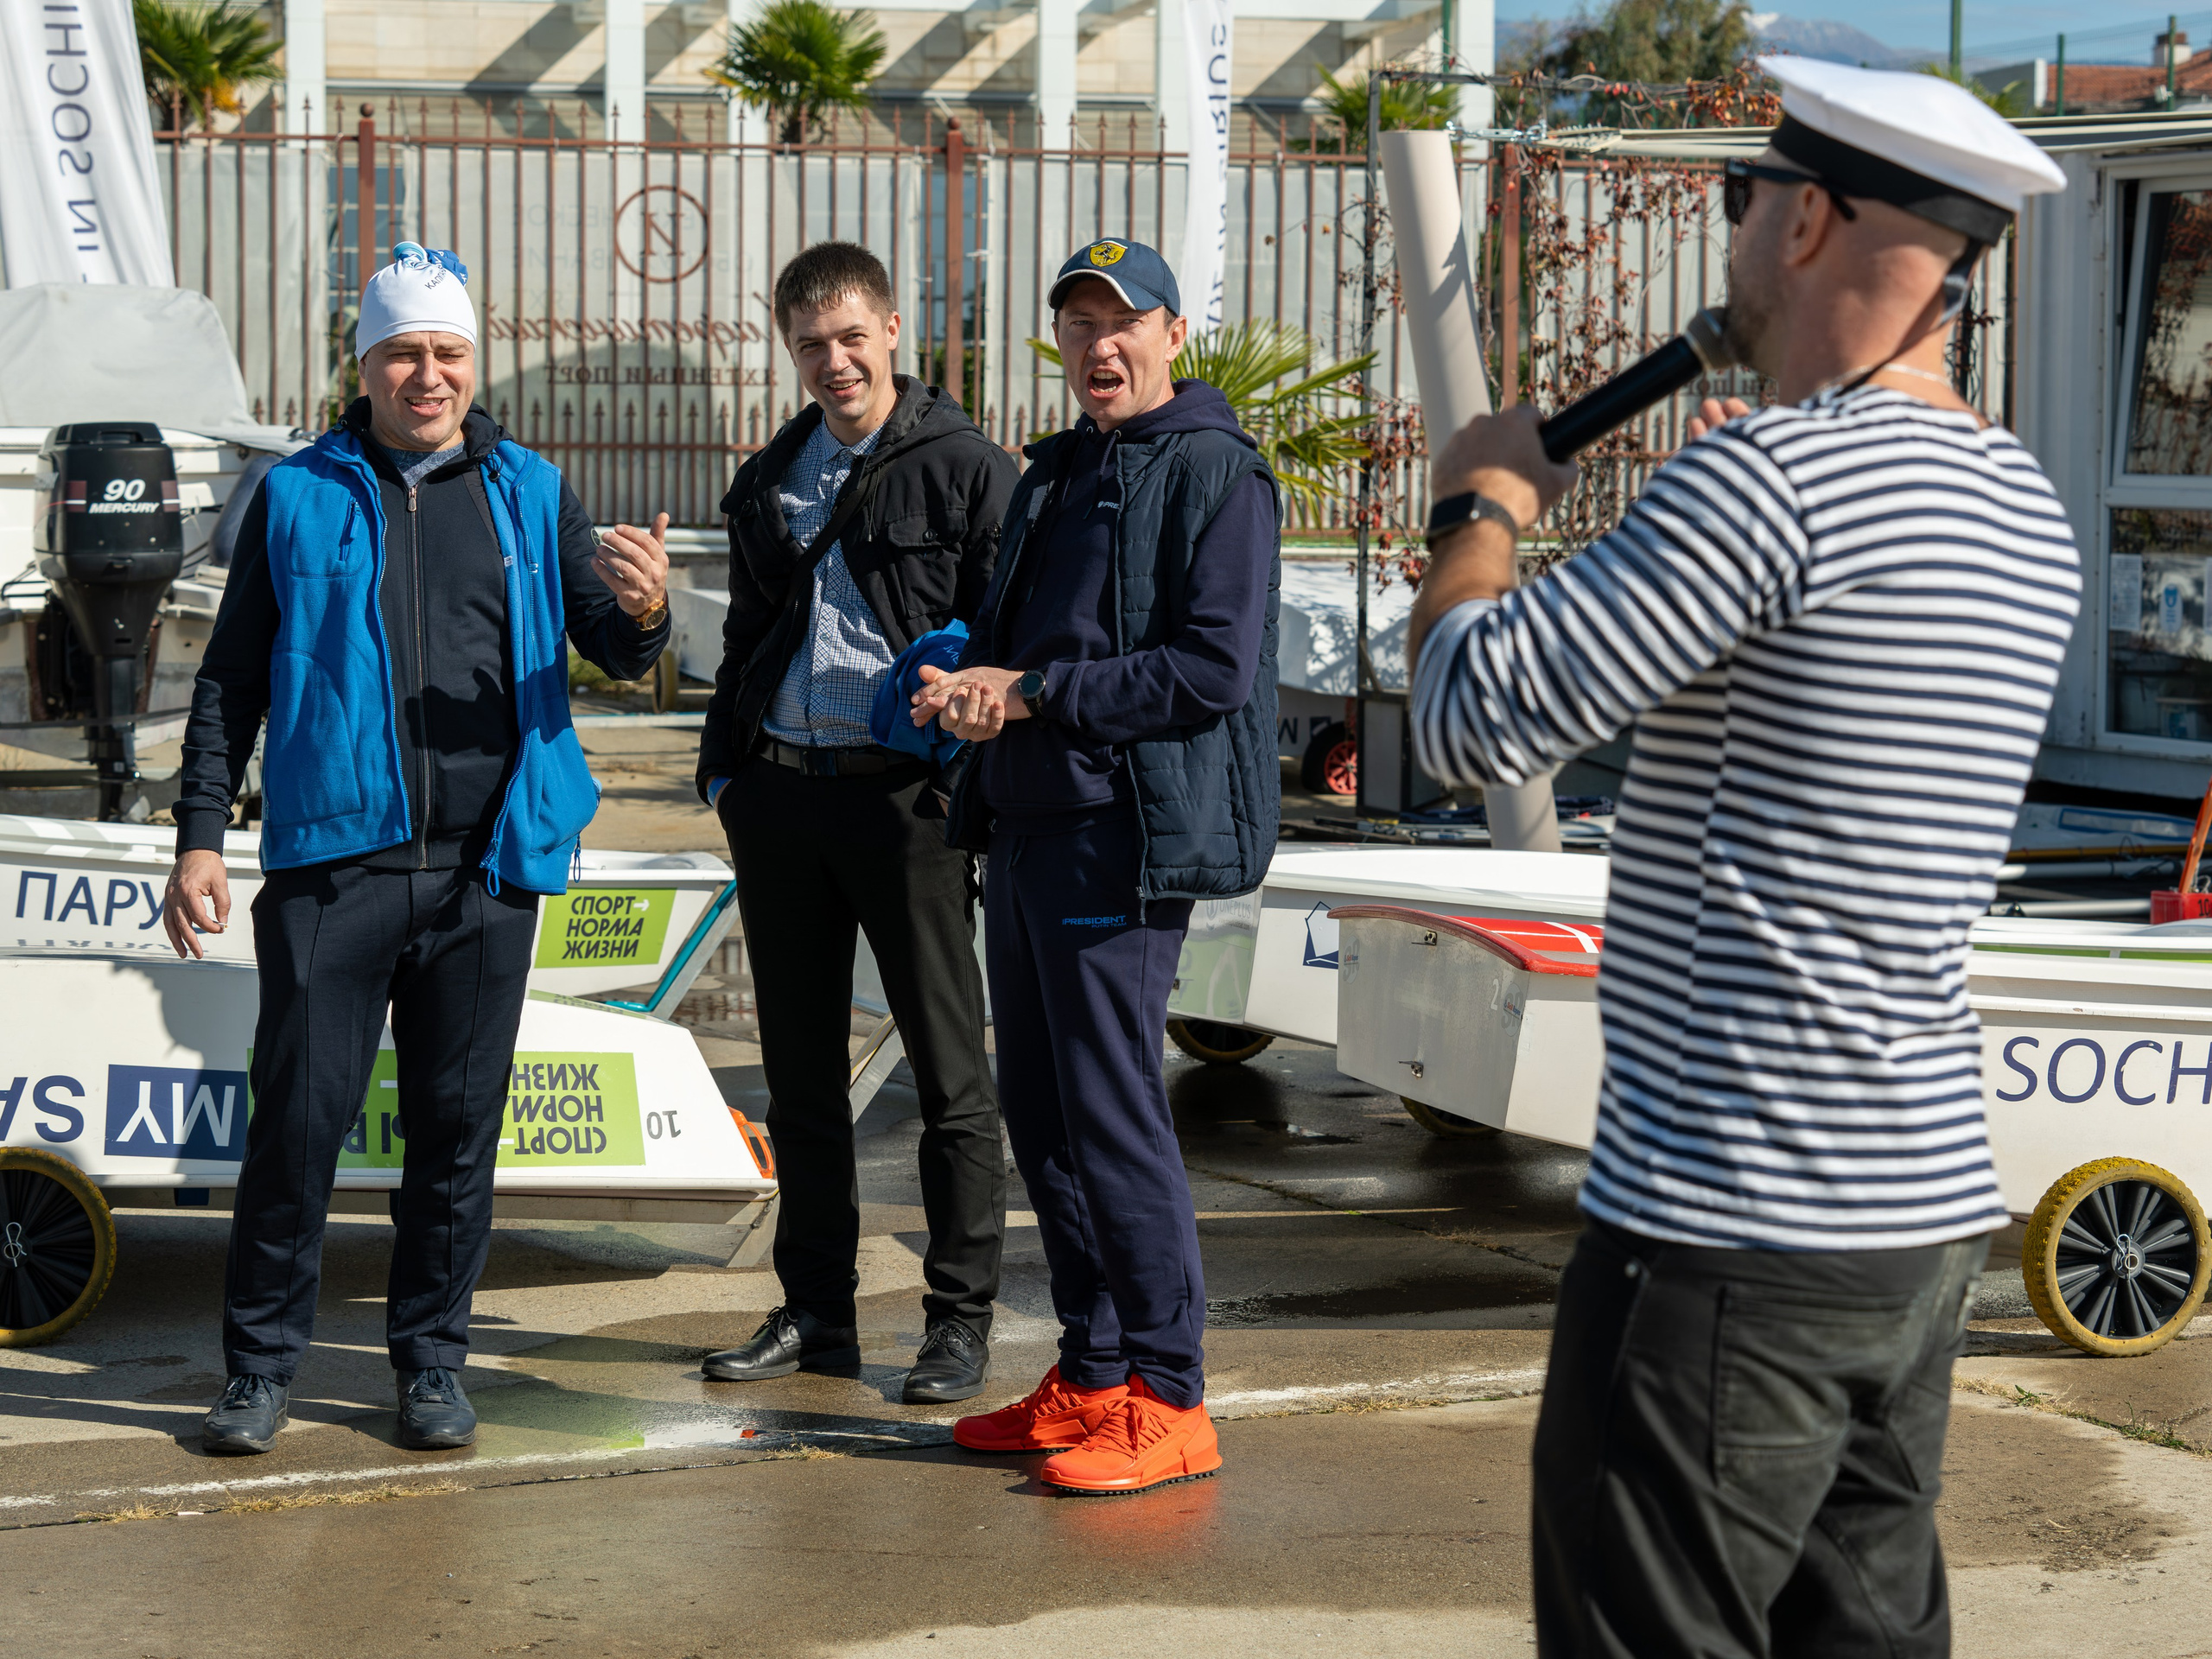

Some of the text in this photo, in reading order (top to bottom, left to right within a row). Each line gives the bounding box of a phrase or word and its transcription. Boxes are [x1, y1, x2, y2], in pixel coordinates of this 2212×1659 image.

[104, 479, 146, 502] 90
[88, 502, 160, 514] MERCURY
[16, 870, 210, 934] ПАРУ
[571, 896, 636, 915] СПОРТ
[566, 918, 645, 938] НОРМА
[562, 939, 639, 960] ЖИЗНИ
[1491, 978, 1500, 1011] 2
[512, 1063, 601, 1090] ЖИЗН
[506, 1095, 604, 1123] НОРМ
[646, 1109, 682, 1140] 10
[514, 1127, 607, 1155] СПОРТ
